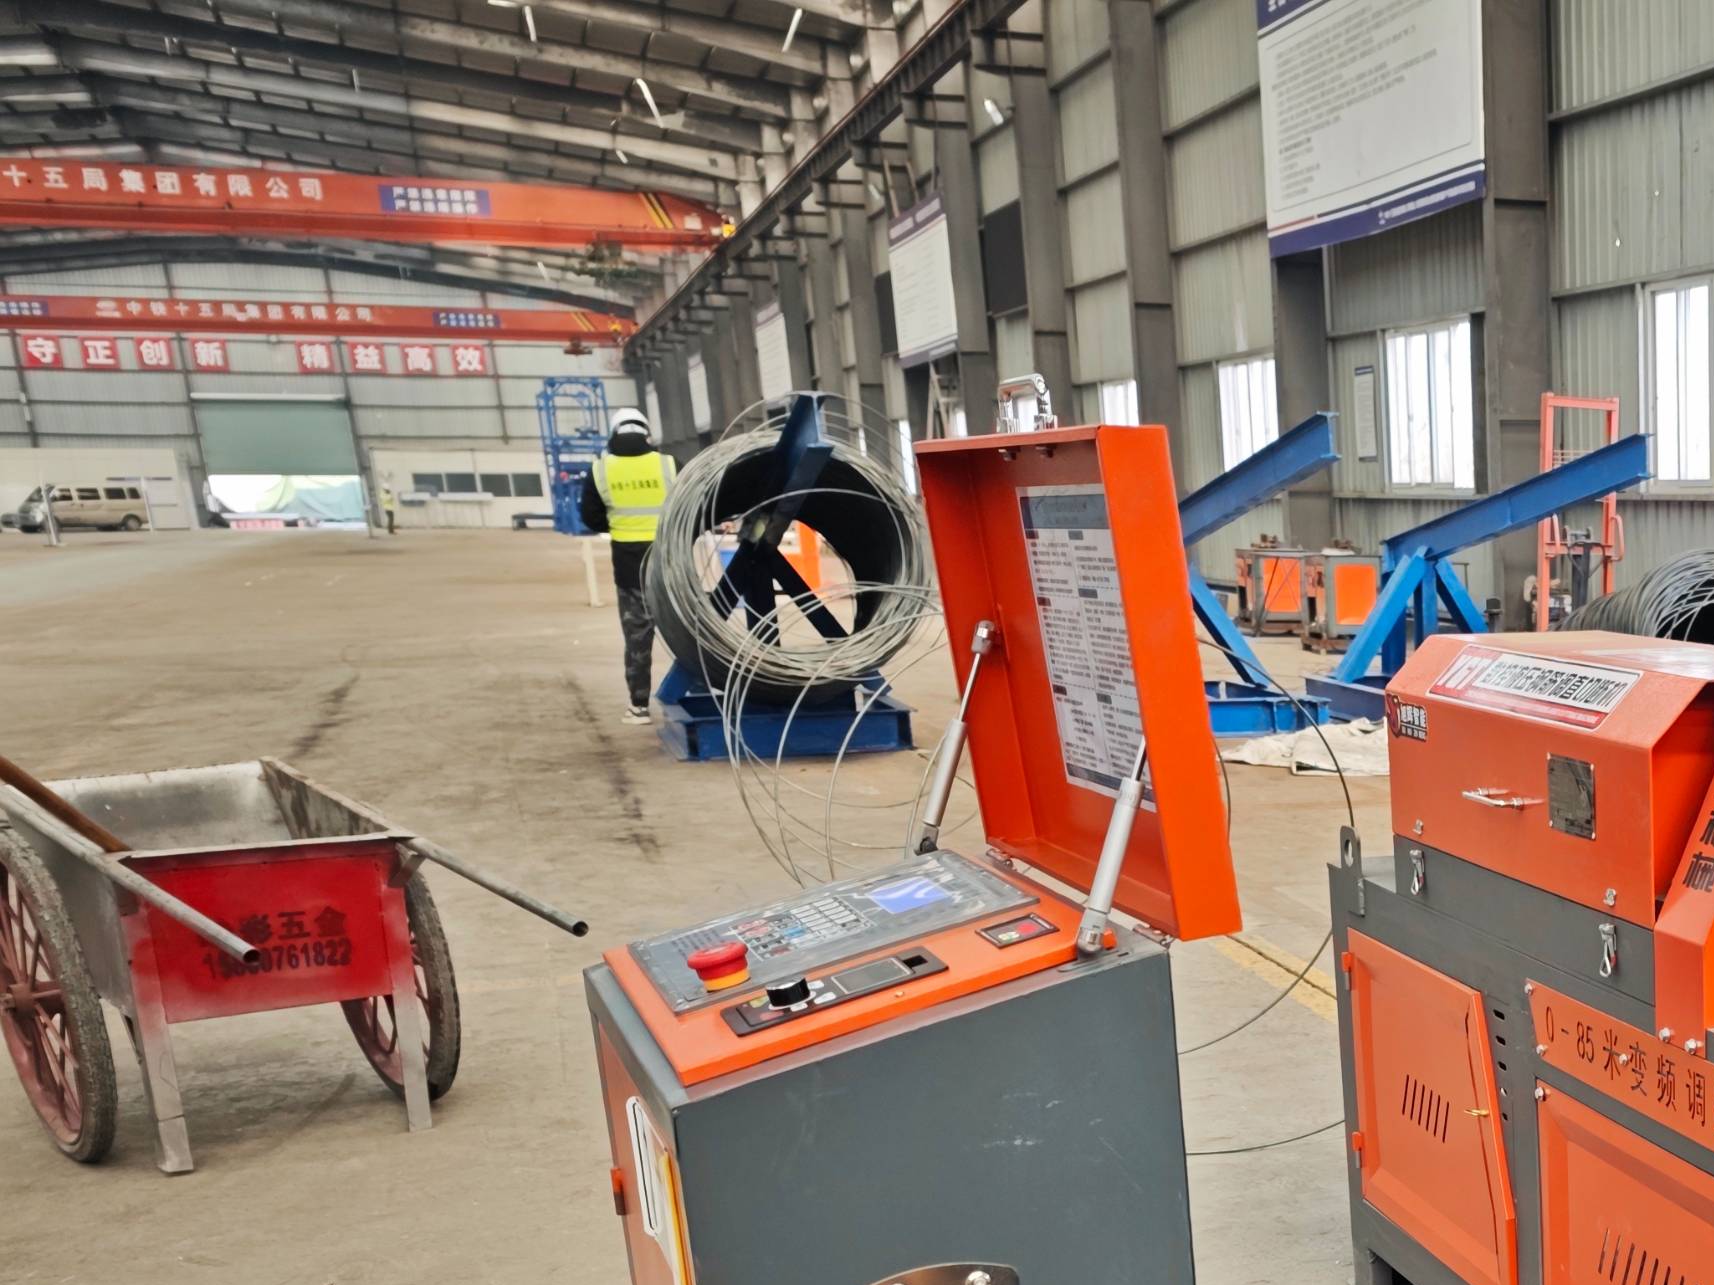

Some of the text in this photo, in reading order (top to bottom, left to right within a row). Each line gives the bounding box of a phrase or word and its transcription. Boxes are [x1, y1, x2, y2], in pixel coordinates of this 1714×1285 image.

[2, 164, 323, 201] 十五局集团有限公司
[27, 337, 483, 372] 守正创新 精益高效
